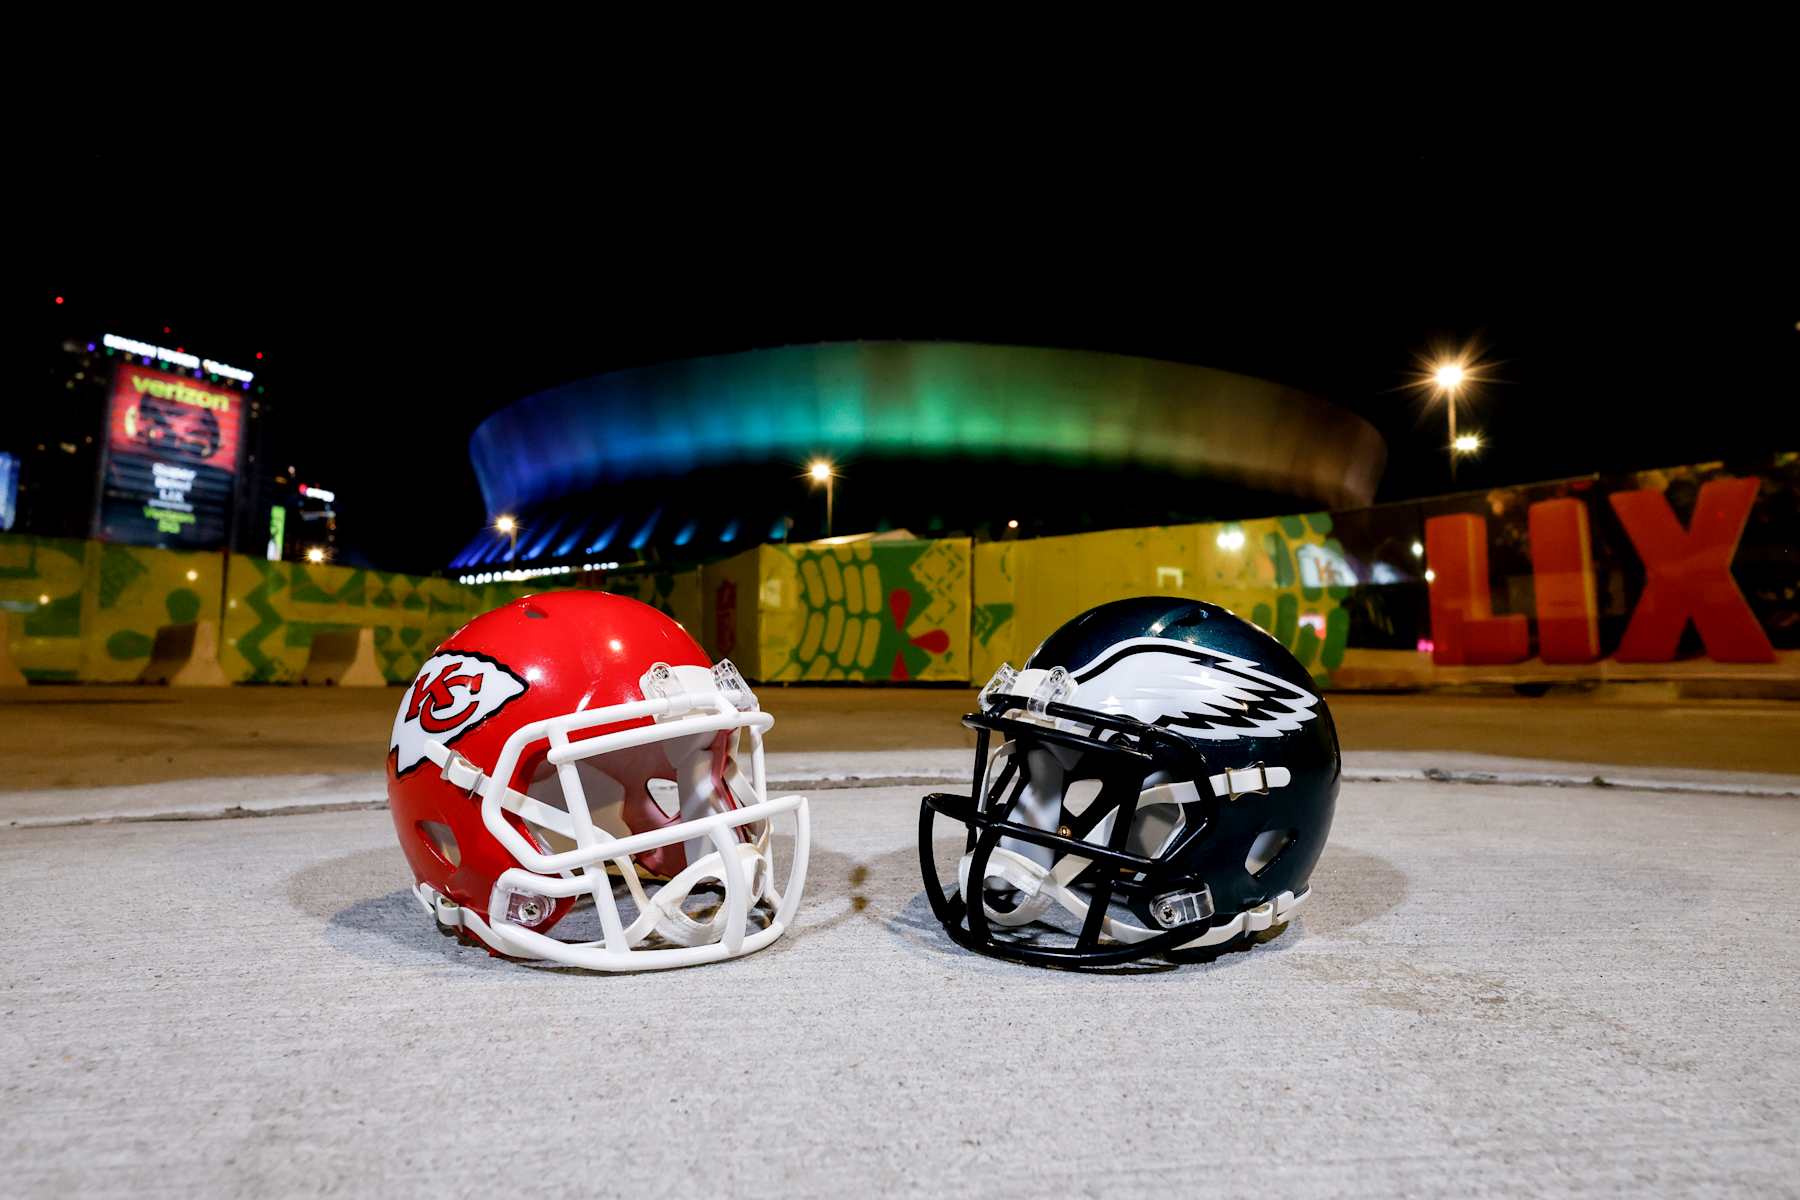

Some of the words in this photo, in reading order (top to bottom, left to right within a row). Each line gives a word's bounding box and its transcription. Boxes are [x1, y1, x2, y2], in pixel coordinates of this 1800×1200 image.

[131, 375, 230, 412] verizon
[1425, 475, 1777, 666] LIX
[404, 661, 484, 734] KC
